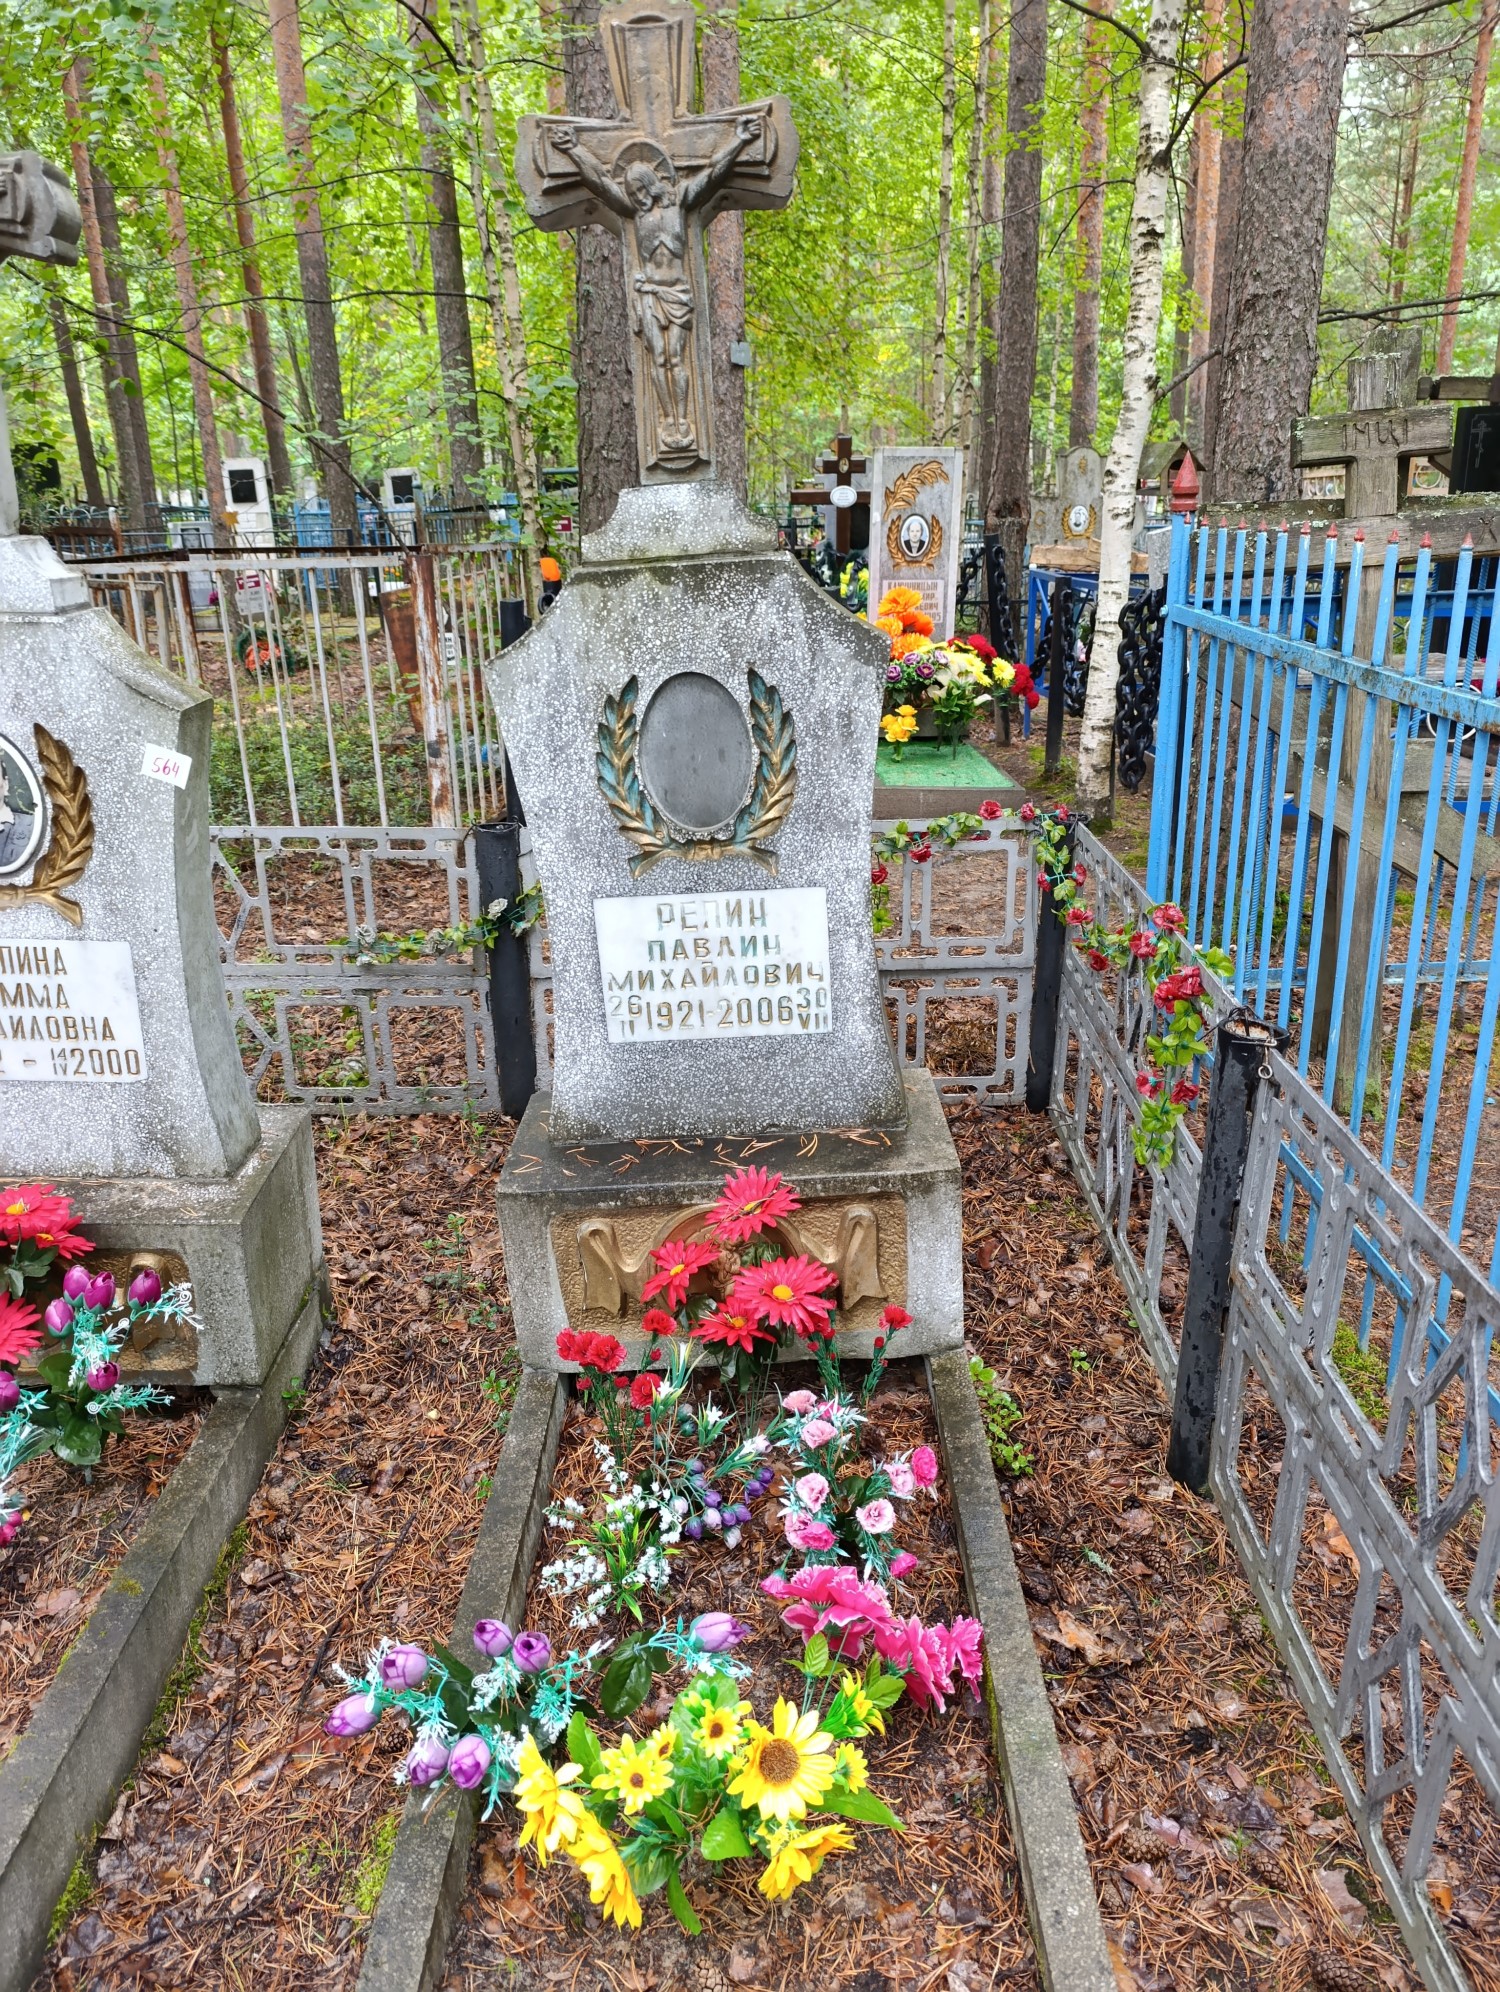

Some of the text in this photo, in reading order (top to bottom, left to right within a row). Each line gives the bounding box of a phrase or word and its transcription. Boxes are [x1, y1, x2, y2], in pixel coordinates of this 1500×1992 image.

[151, 757, 180, 778] 564
[656, 897, 768, 932] РЕПИН
[647, 934, 782, 962] ПАВЛИН
[607, 961, 824, 992] МИХАЙЛОВИЧ
[608, 994, 643, 1018] 26
[796, 987, 828, 1012] 30
[70, 1048, 141, 1077] 2000
